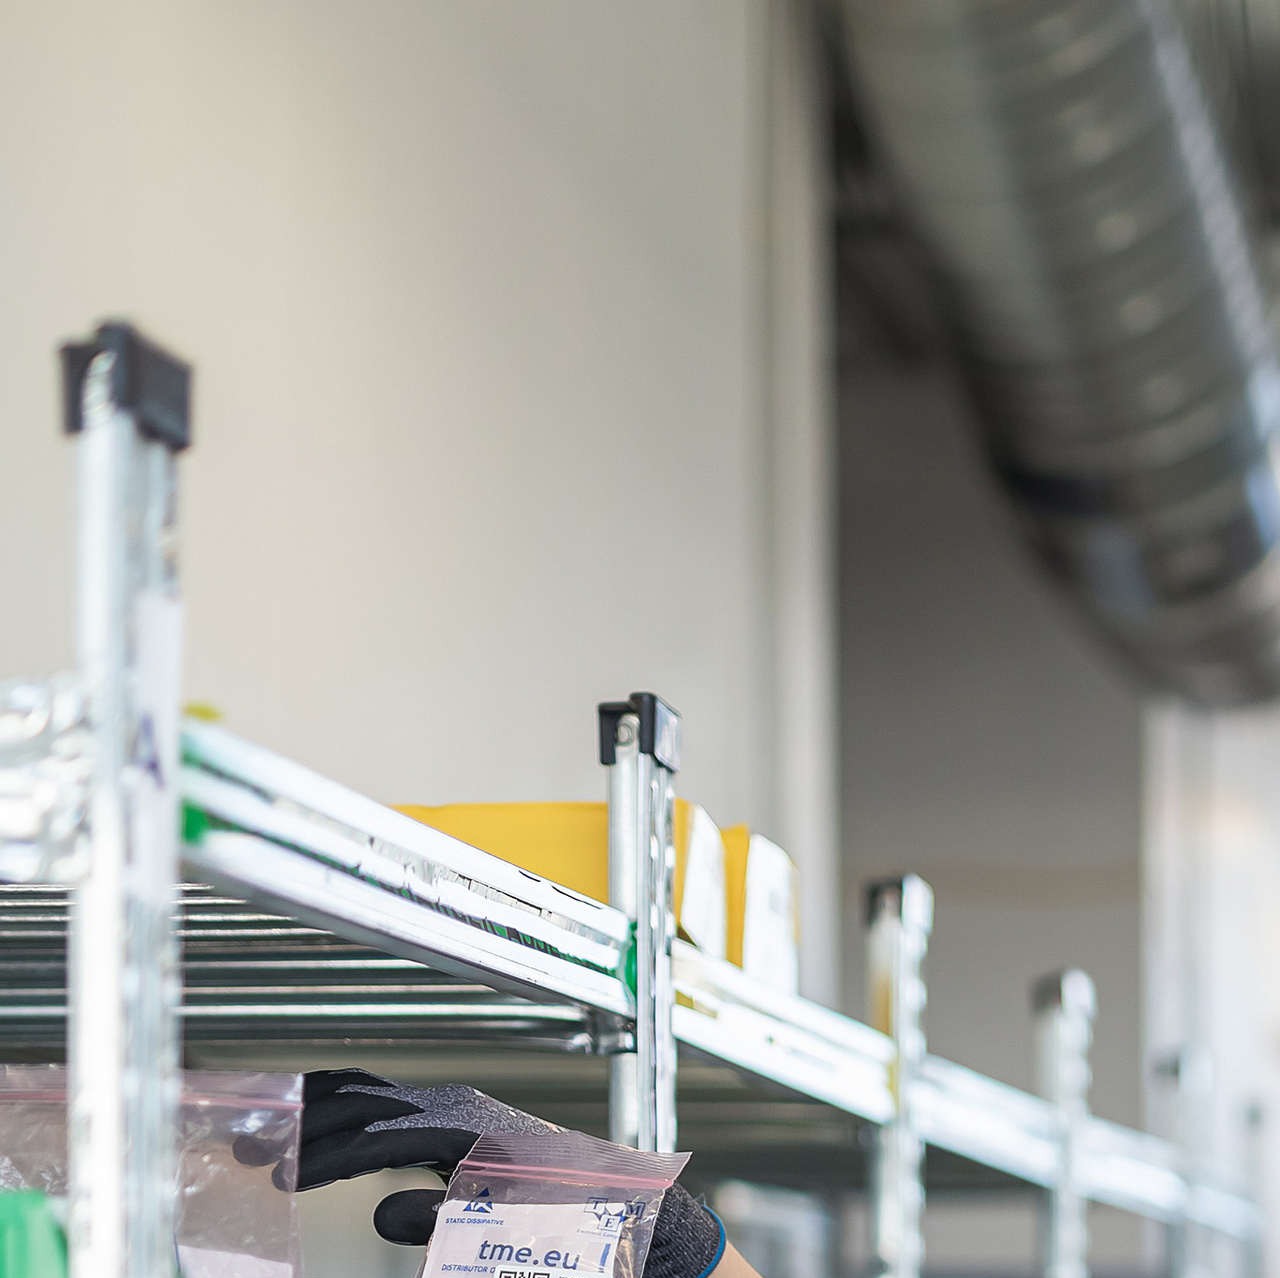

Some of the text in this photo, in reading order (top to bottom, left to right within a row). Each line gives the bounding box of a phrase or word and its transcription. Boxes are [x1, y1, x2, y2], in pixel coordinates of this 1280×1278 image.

[466, 1217, 505, 1226] DISSIPATIVE
[478, 1239, 581, 1271] tme.eu
[441, 1263, 489, 1274] DISTRIBUTOR
